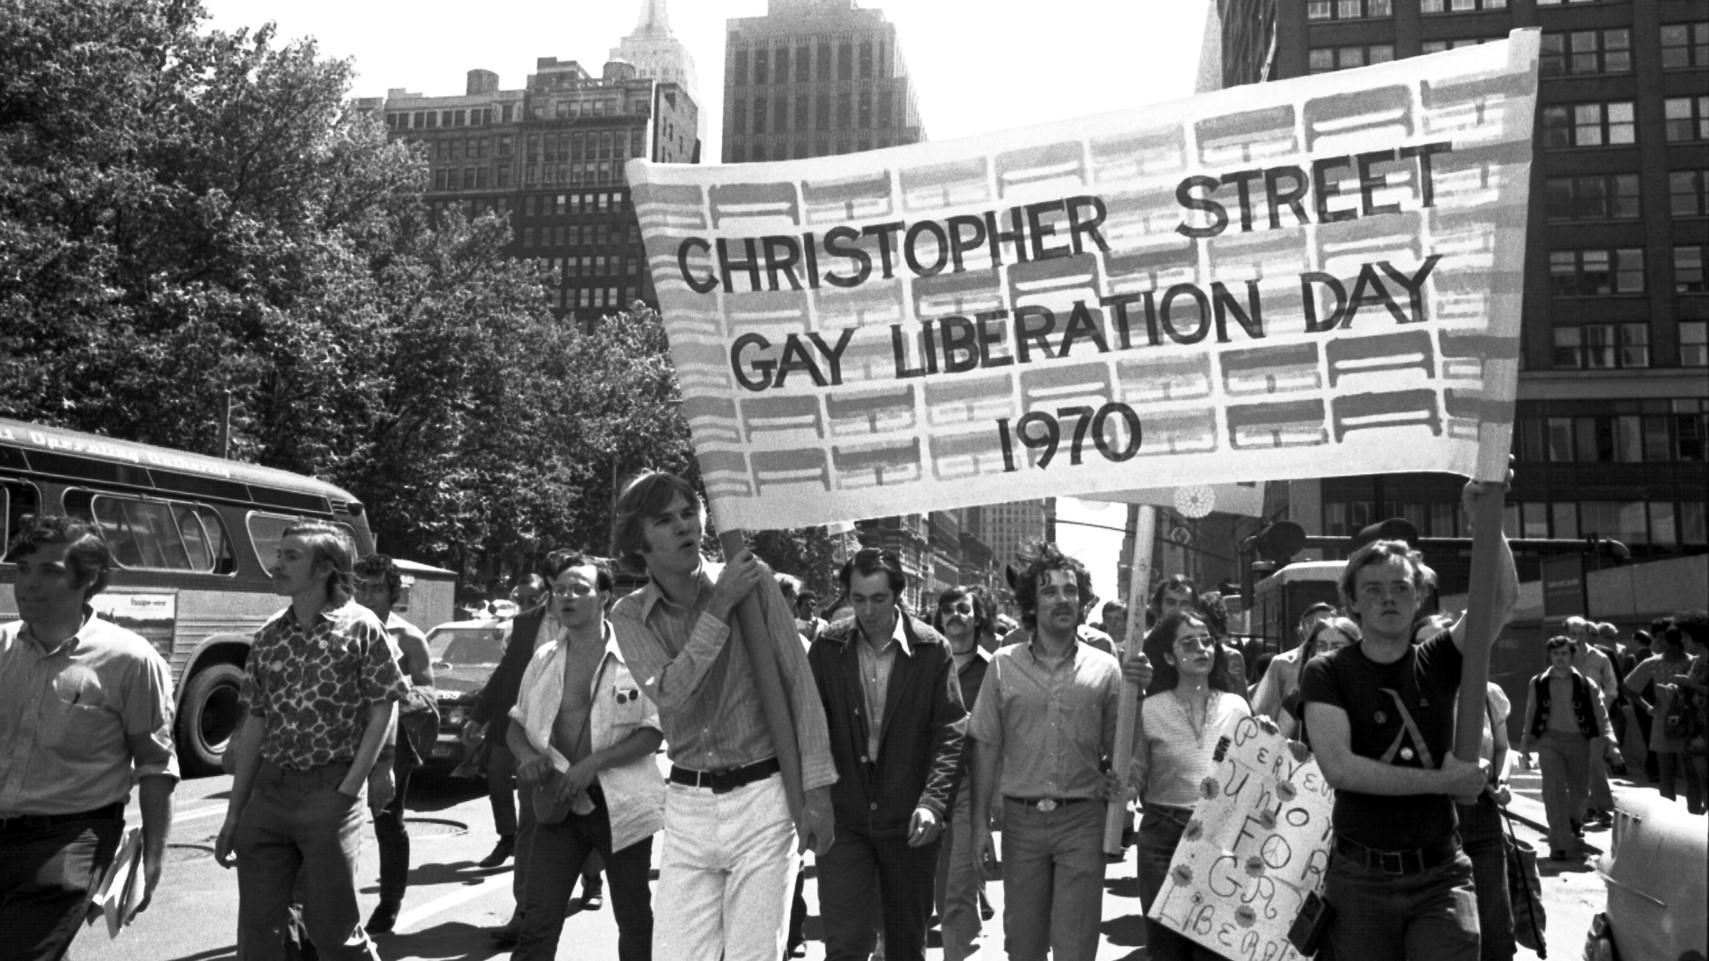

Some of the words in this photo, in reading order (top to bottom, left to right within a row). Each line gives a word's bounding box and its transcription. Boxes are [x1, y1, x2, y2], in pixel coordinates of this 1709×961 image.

[677, 195, 1111, 294] CHRISTOPHER
[1175, 141, 1452, 238] STREET
[730, 327, 859, 392] GAY
[890, 279, 1266, 380] LIBERATION
[1299, 254, 1444, 333] DAY
[996, 402, 1143, 473] 1970
[1231, 814, 1329, 891] FOR
